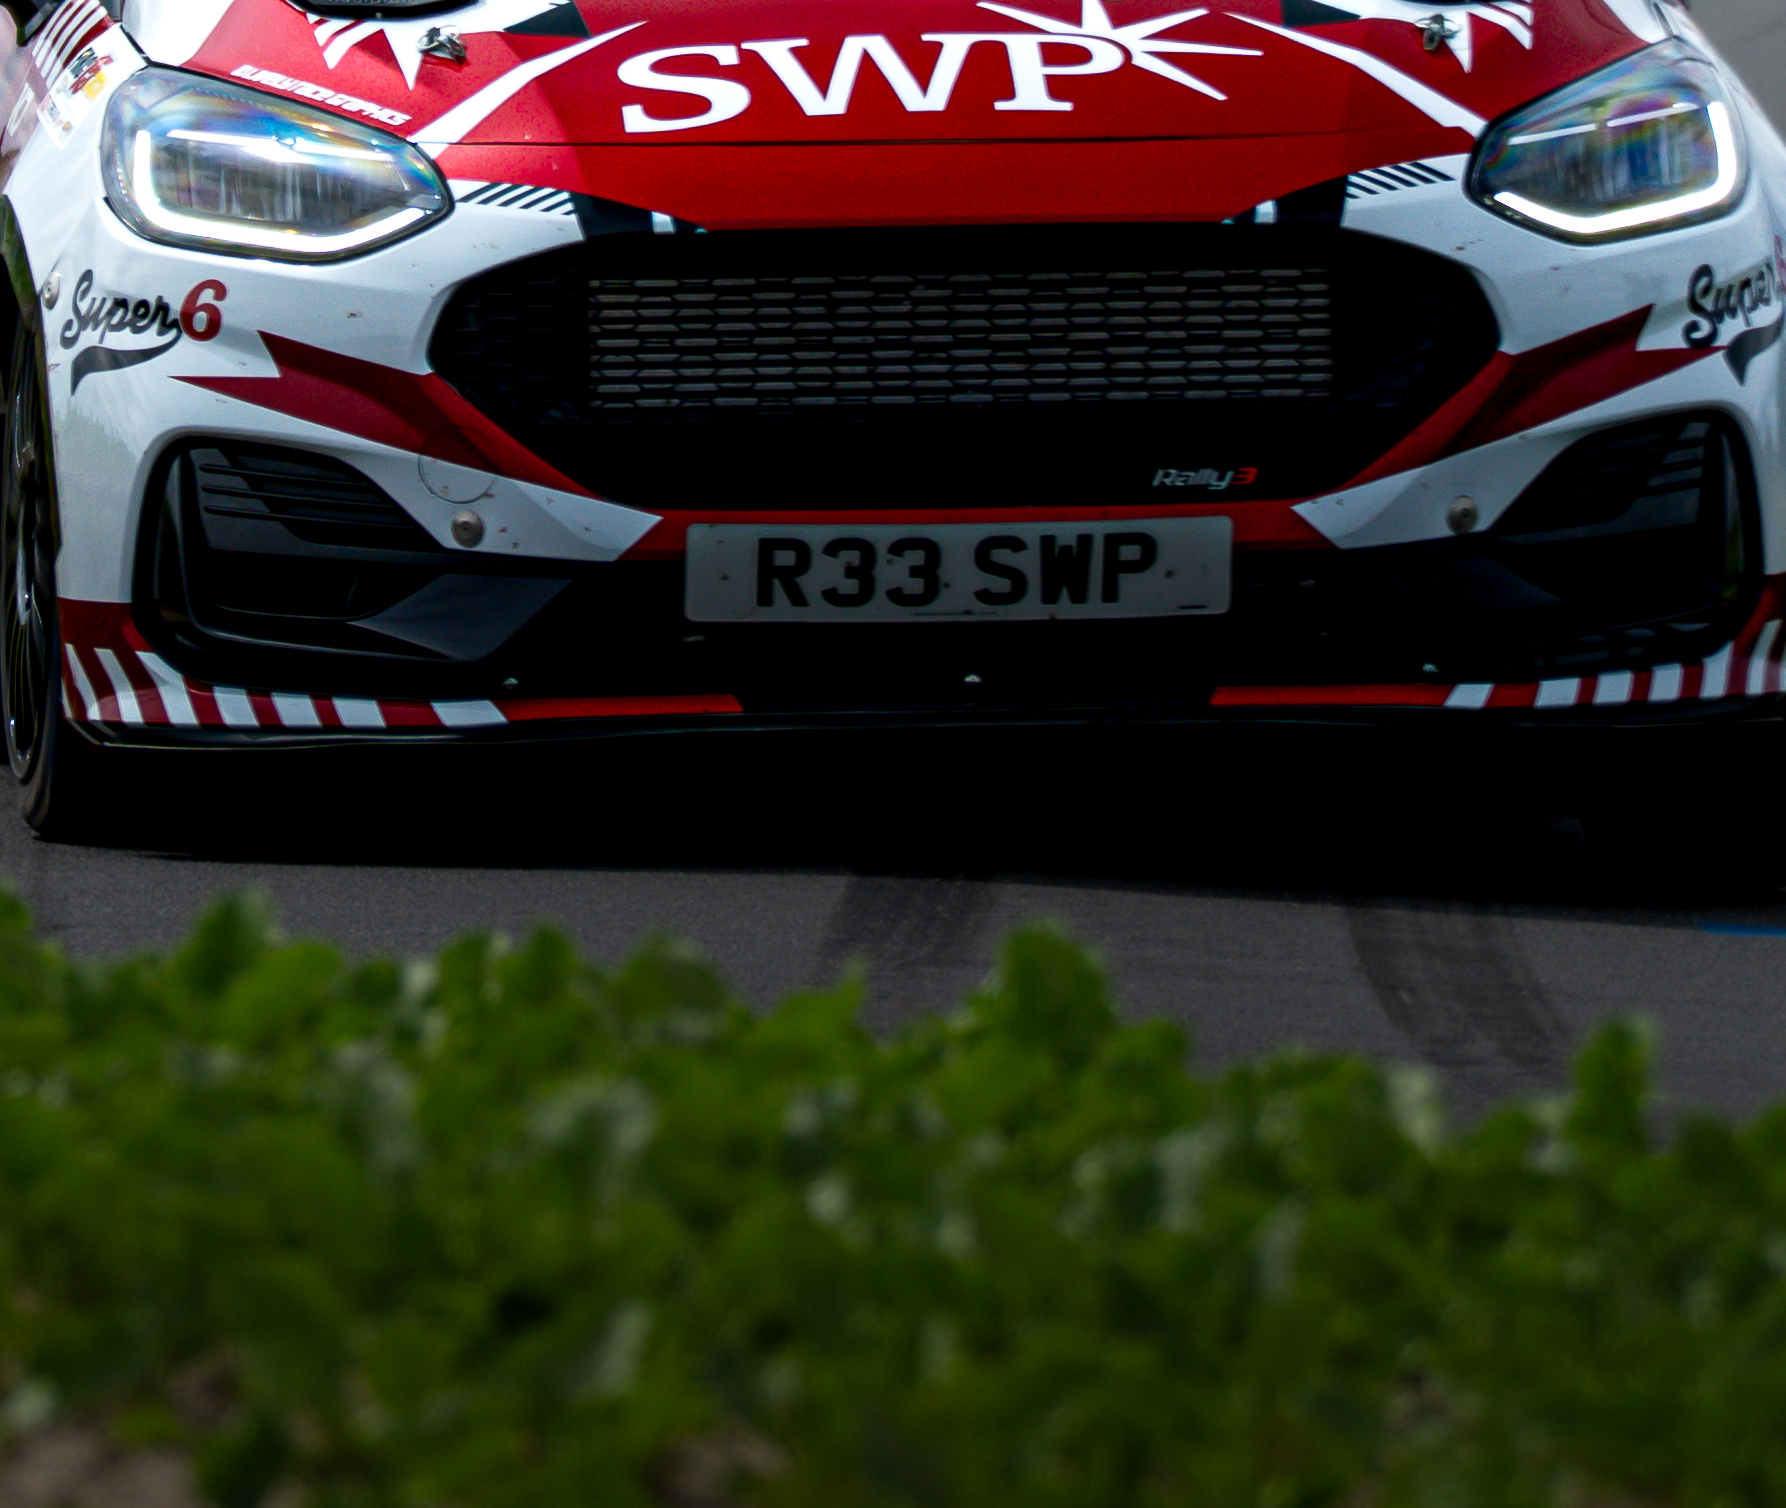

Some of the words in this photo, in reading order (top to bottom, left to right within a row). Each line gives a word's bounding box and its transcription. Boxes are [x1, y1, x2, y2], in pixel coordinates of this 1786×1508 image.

[616, 33, 1126, 133] SWP
[756, 536, 943, 609] R33
[972, 531, 1159, 606] SWP
